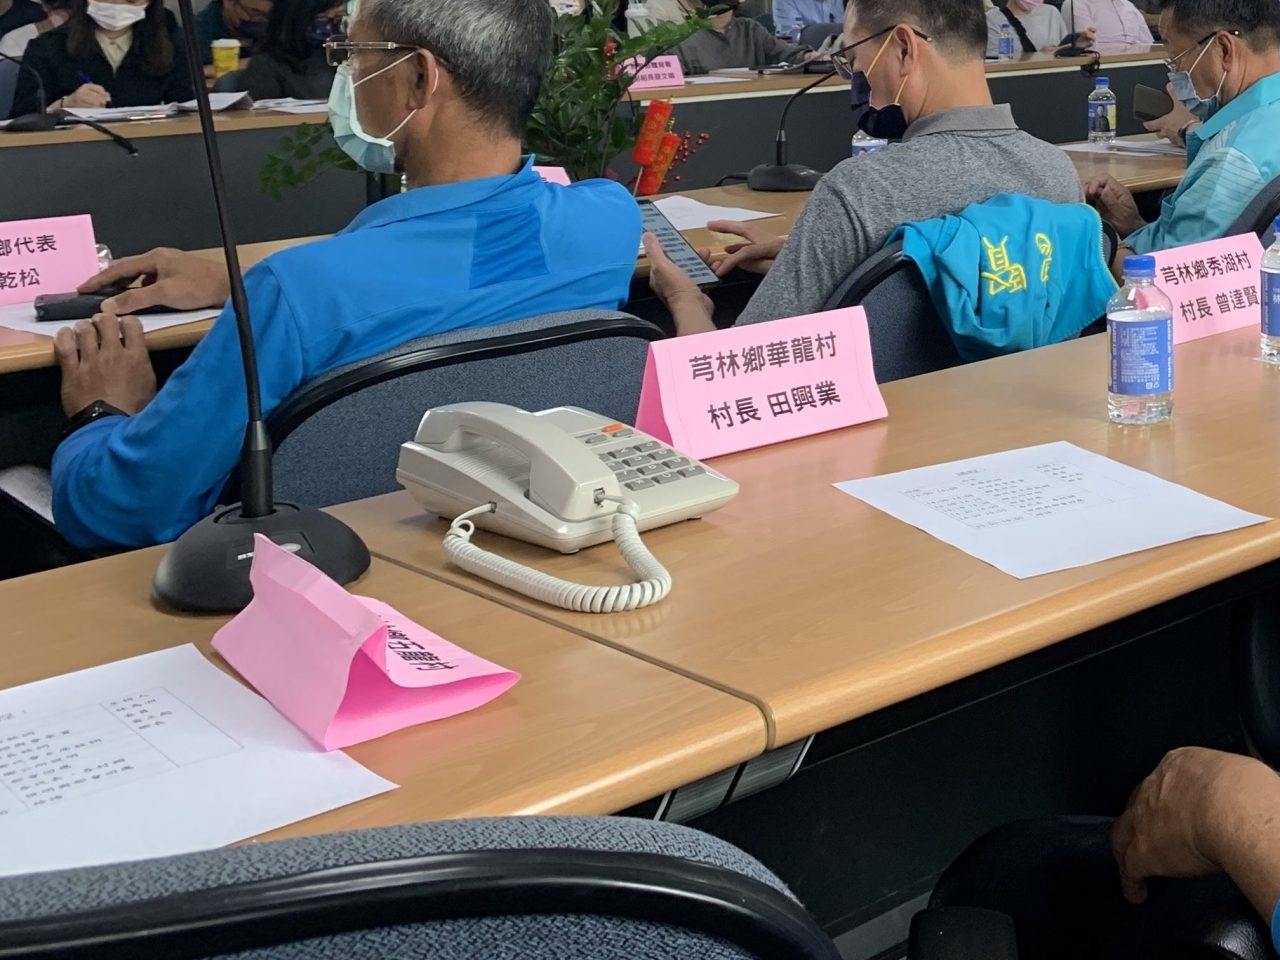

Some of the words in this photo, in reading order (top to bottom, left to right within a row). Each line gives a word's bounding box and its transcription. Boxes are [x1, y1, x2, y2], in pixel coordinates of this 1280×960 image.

[1160, 250, 1252, 286] 芎林鄉秀湖村
[1179, 293, 1213, 323] 村長
[1215, 285, 1260, 315] 曾達賢
[688, 331, 837, 382] 芎林鄉華龍村
[707, 396, 762, 430] 村長
[767, 380, 841, 418] 田興業
